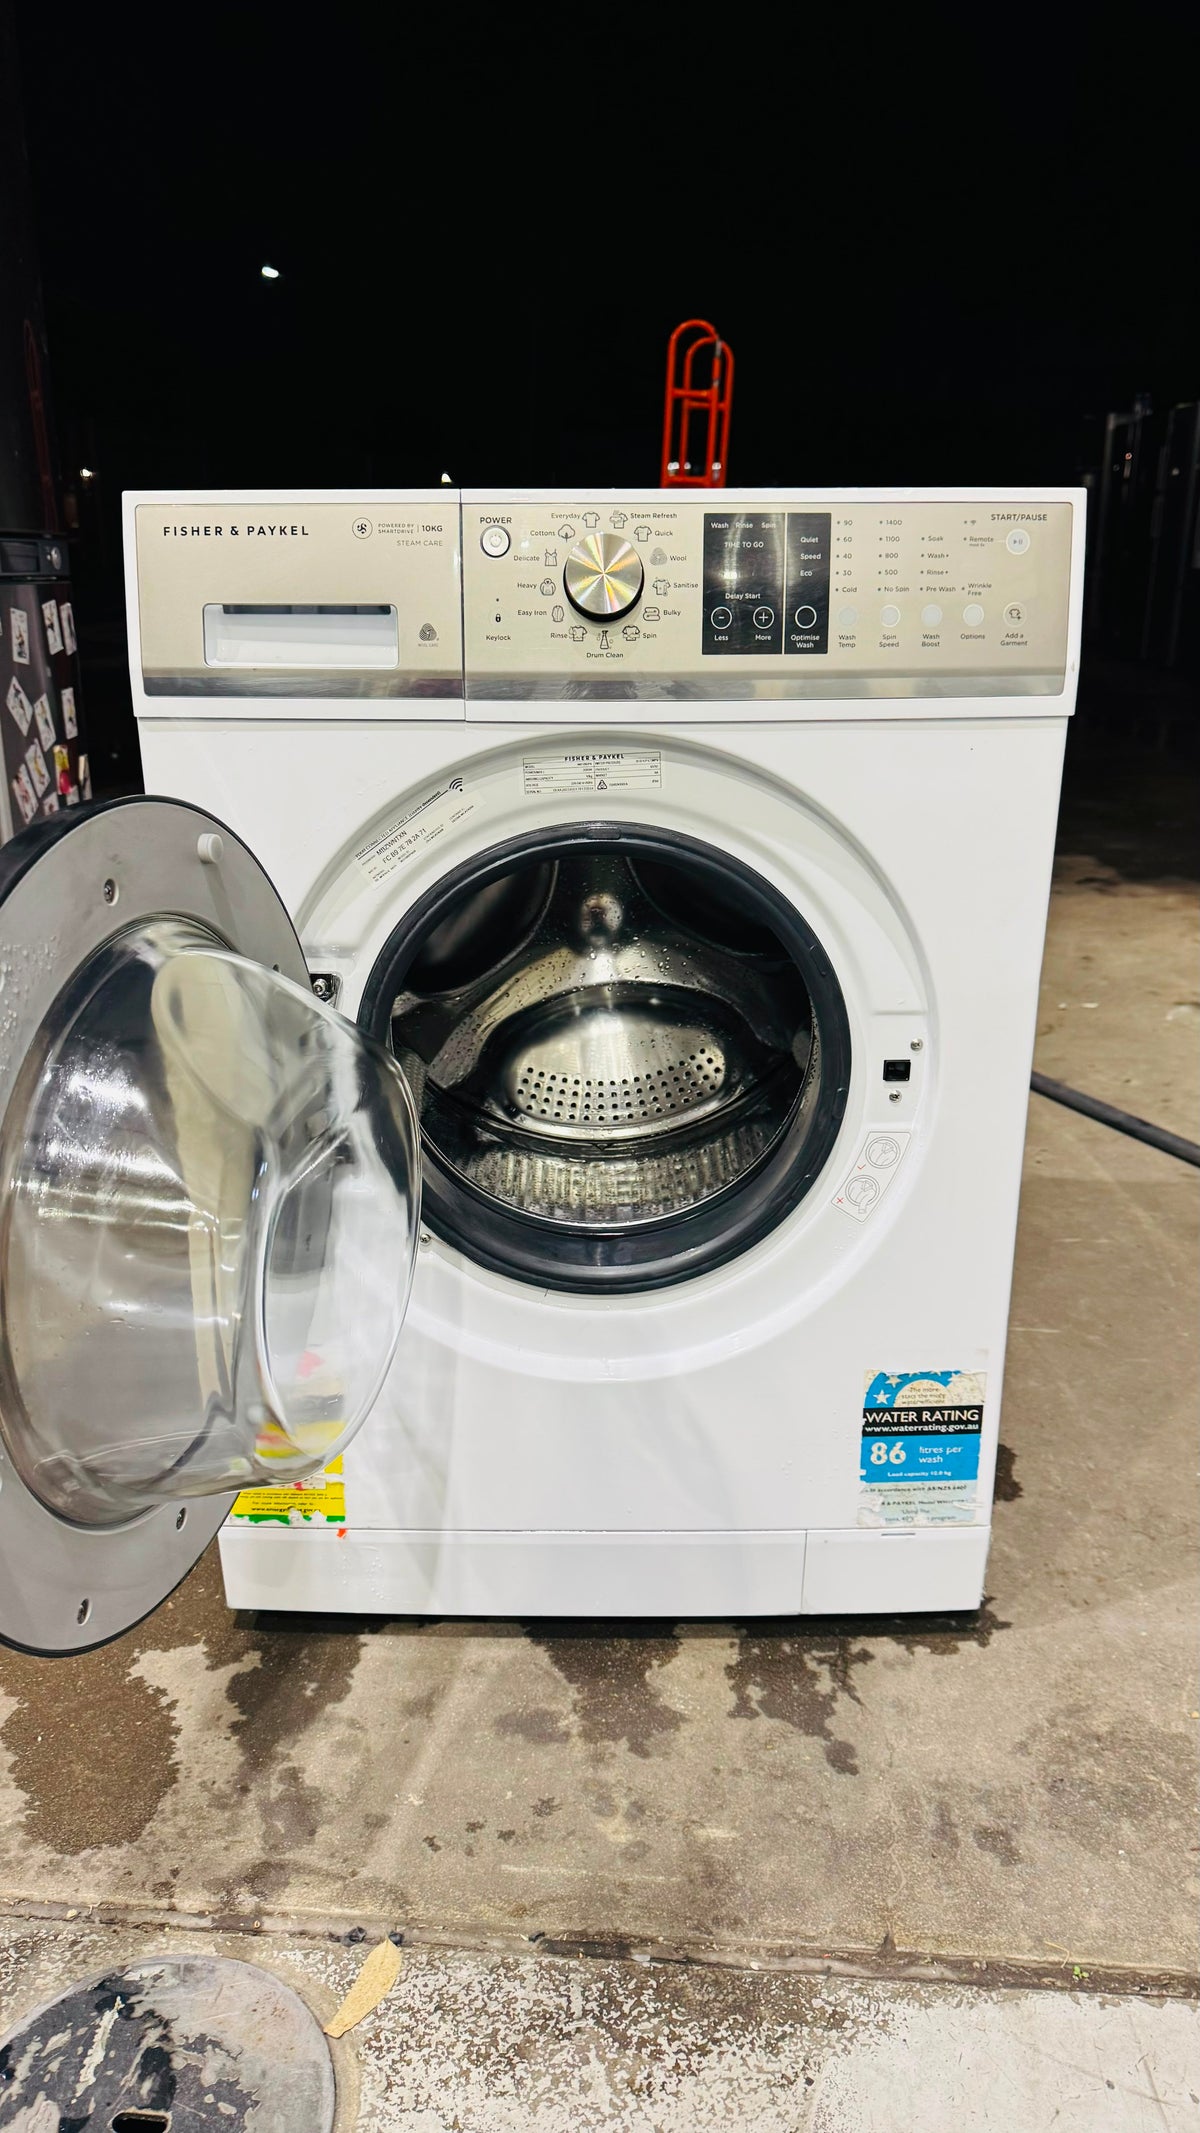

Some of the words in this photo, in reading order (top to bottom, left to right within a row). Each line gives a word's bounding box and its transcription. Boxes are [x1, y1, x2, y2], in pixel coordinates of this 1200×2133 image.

[551, 513, 580, 521] Everyday
[991, 513, 1048, 522] START/PAUSE
[761, 522, 776, 530] Spin
[163, 526, 224, 537] FISHER
[230, 526, 240, 536] &
[247, 525, 309, 536] PAYKEL
[517, 582, 537, 590] Heavy
[486, 634, 511, 642] Keylock
[642, 632, 657, 640] Spin
[790, 634, 820, 642] Optimise
[960, 633, 985, 641] Options
[382, 855, 392, 864] FC
[412, 833, 420, 842] 2A
[866, 1411, 918, 1423] WATER
[922, 1409, 979, 1421] RATING
[864, 1423, 979, 1433] www.waterrating.gov.au
[870, 1441, 907, 1465] 86
[919, 1446, 943, 1454] litres
[946, 1446, 963, 1455] per
[919, 1455, 943, 1463] wash
